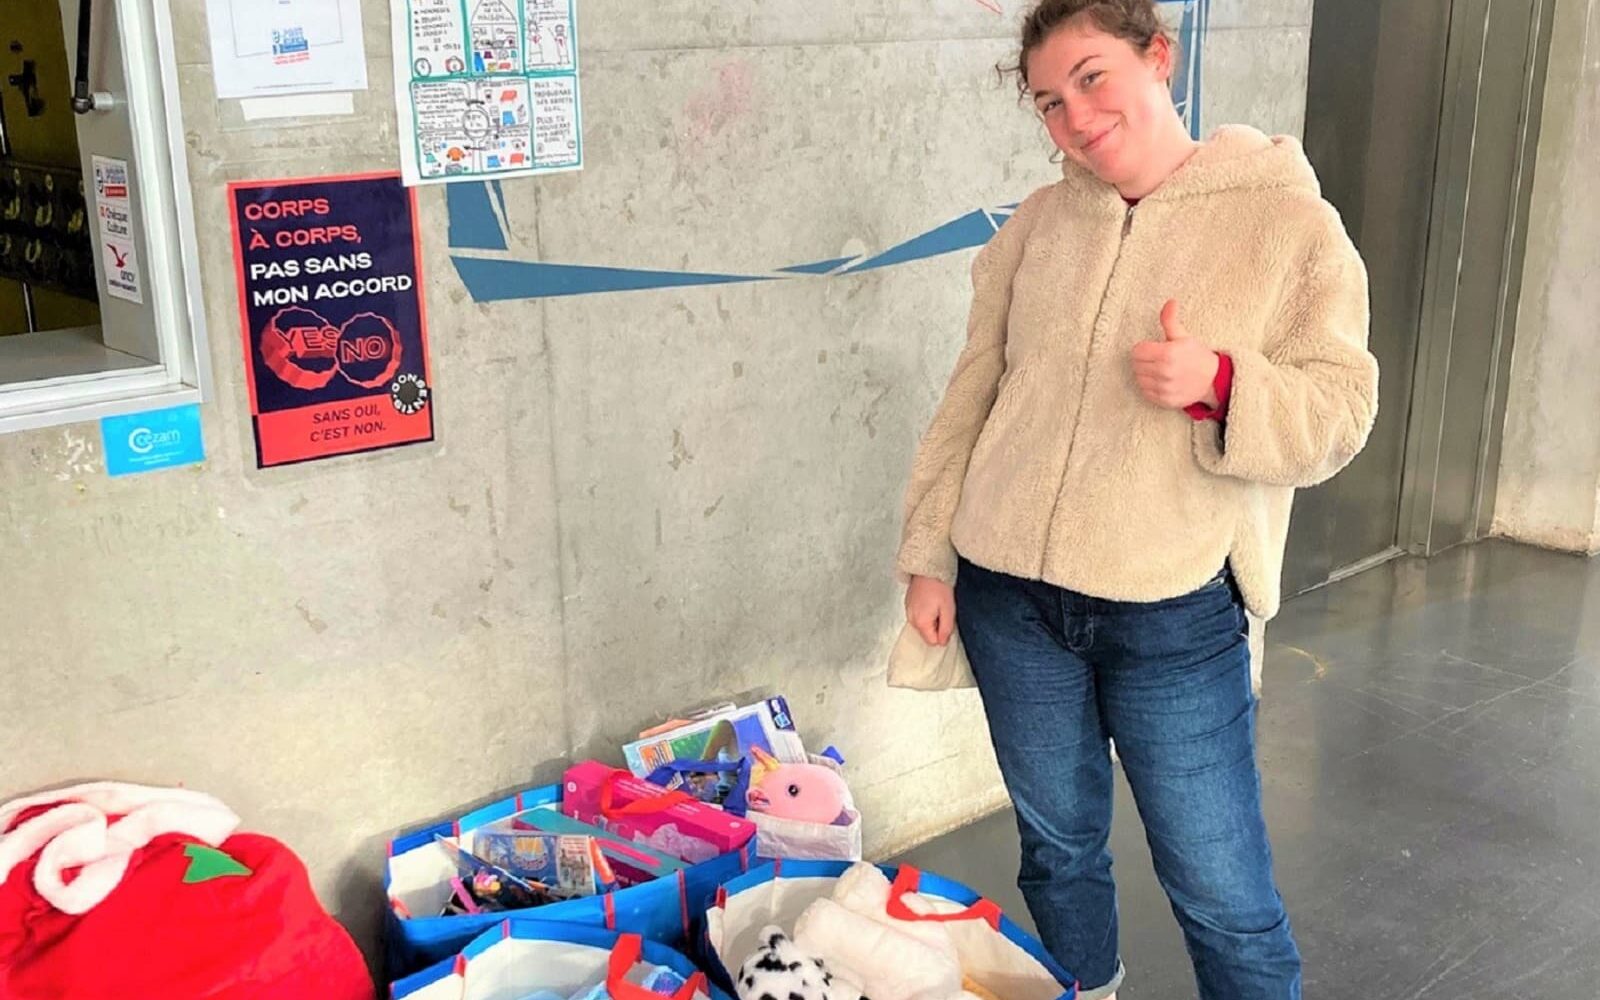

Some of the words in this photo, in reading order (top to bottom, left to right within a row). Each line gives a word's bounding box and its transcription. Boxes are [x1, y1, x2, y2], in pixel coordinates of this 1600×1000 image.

[245, 198, 330, 220] CORPS
[249, 227, 270, 250] À
[275, 224, 362, 247] CORPS,
[250, 259, 301, 280] PAS
[304, 252, 373, 274] SANS
[253, 285, 309, 306] MON
[313, 275, 412, 300] ACCORD
[270, 325, 338, 356] YES
[340, 335, 386, 363] NO
[312, 408, 351, 424] SANS
[310, 426, 350, 442] C'EST
[354, 421, 387, 435] NON.
